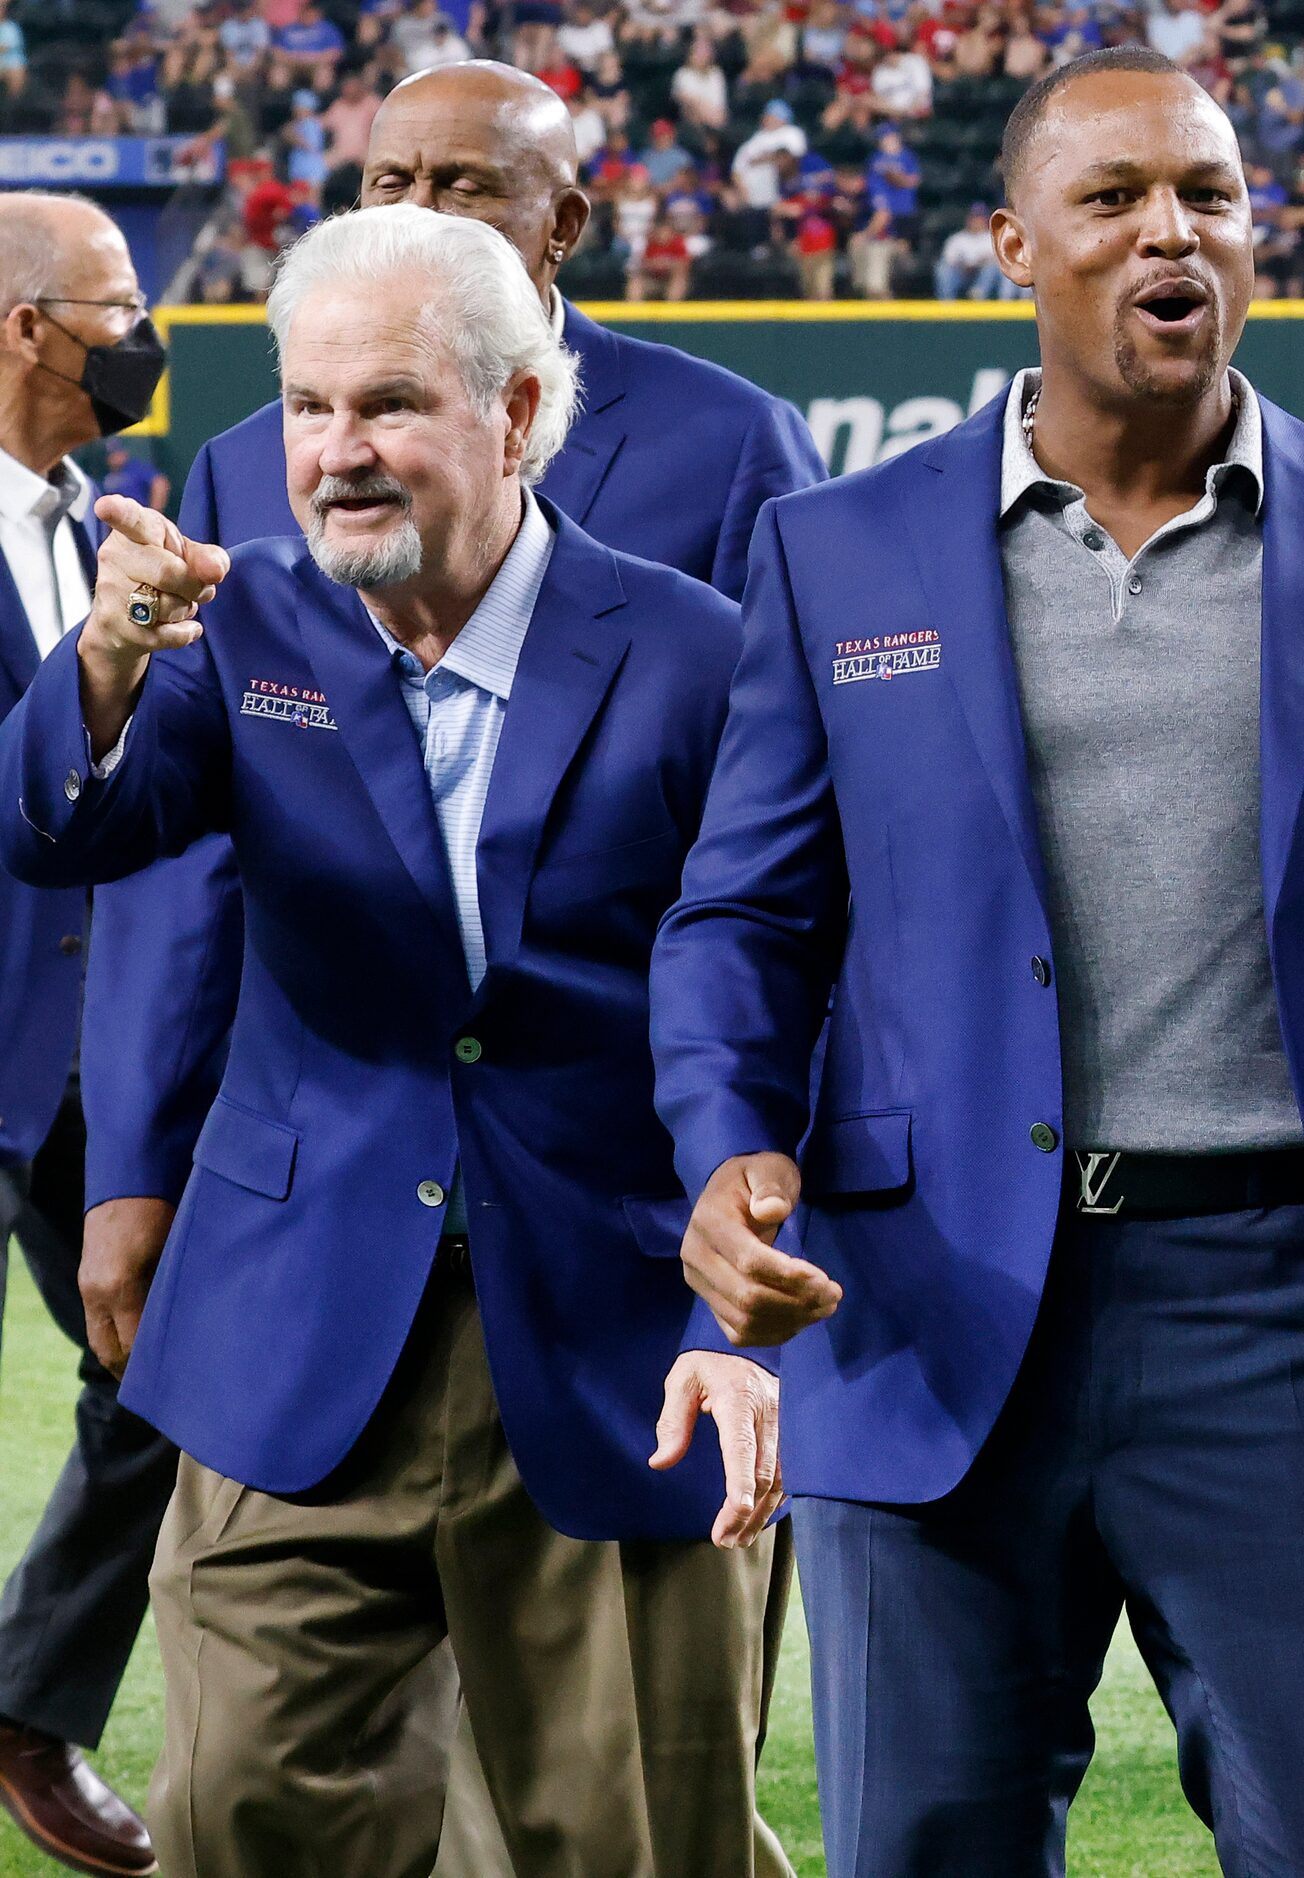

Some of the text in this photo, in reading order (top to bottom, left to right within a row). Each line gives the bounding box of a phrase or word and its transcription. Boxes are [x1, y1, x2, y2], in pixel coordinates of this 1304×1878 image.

[836, 630, 940, 655] TEXAS RANGERS
[832, 647, 941, 681] HALL OF FAME
[249, 679, 298, 697] TEXAS
[240, 695, 292, 717] HALL
[309, 707, 336, 725] FA
